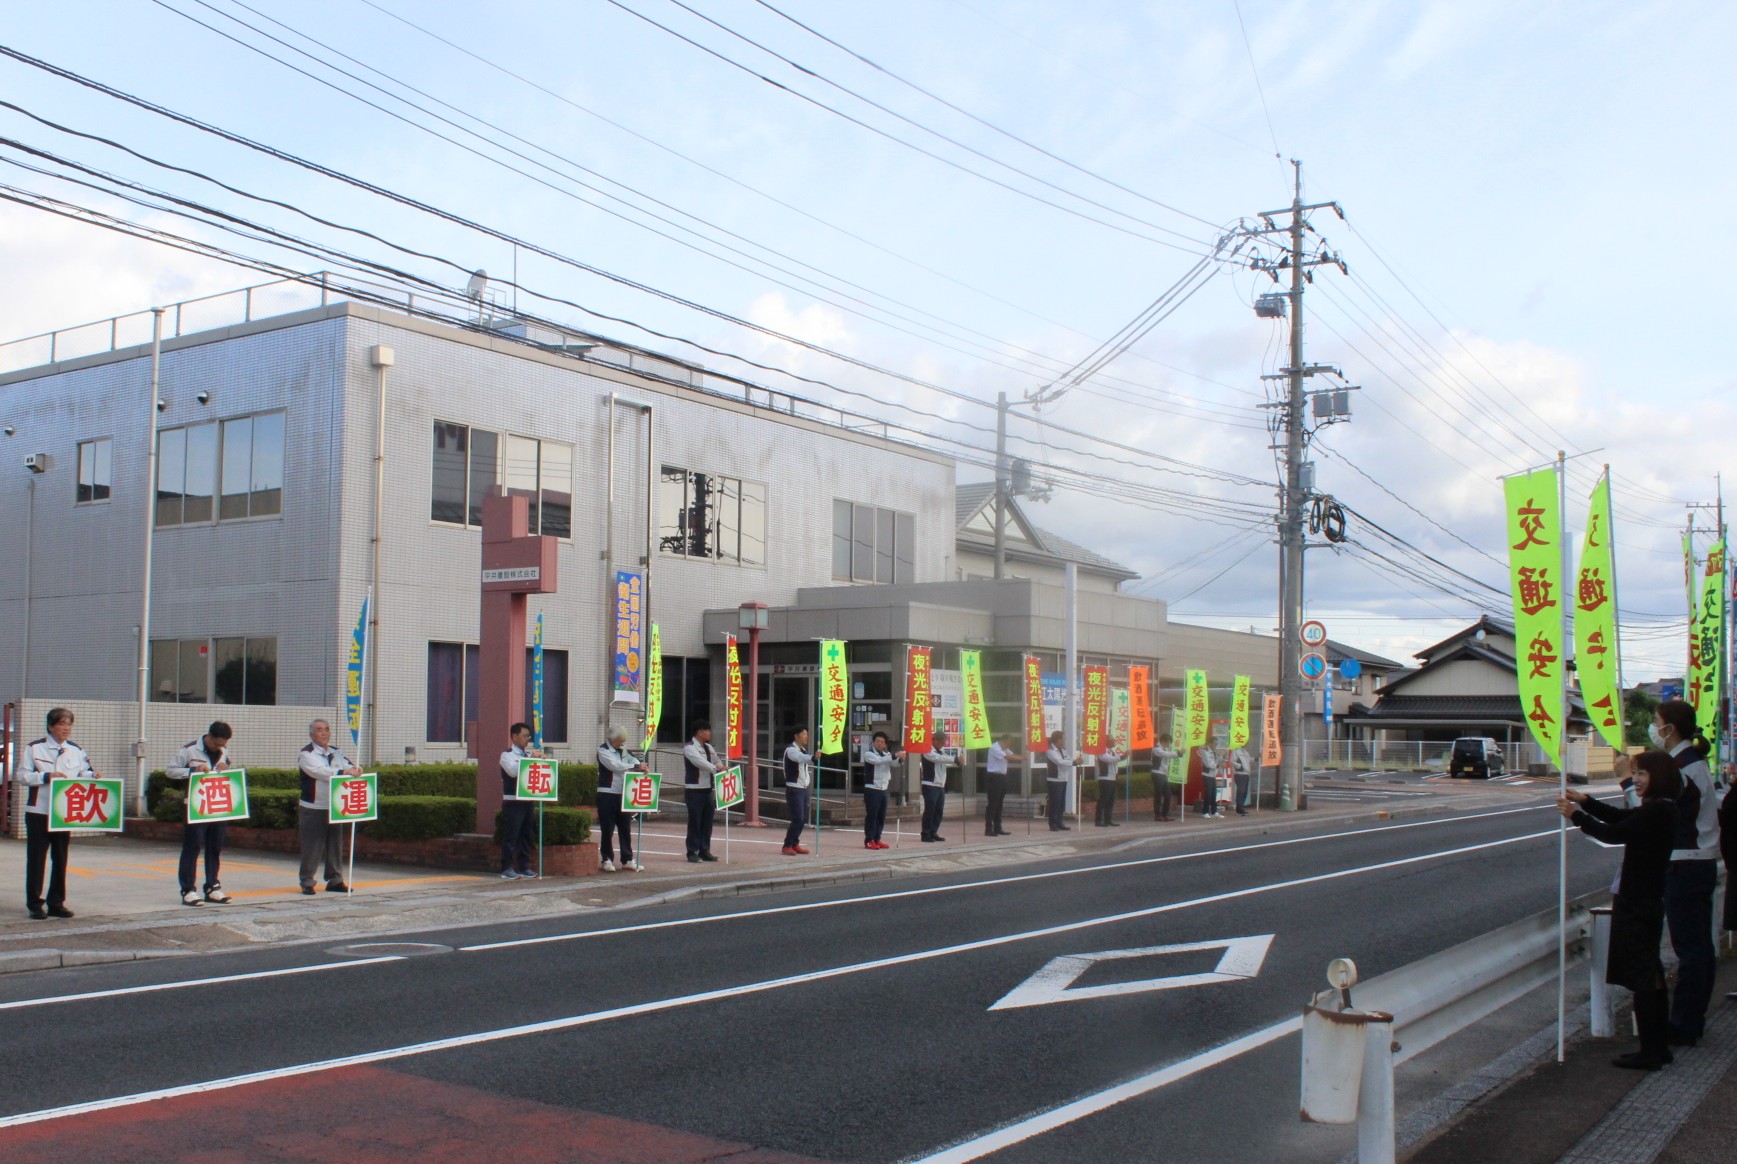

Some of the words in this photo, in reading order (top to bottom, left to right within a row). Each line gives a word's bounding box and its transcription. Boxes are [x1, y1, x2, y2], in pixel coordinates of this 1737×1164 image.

[1306, 628, 1321, 639] 40
[827, 663, 845, 744] 交通安全
[909, 654, 927, 744] 夜光反射材
[966, 672, 986, 740] 交通安全
[1028, 663, 1041, 743] 夜光反射材
[1086, 672, 1102, 746] 夜光反射材
[1133, 671, 1148, 742] 飲酒運転追放
[1191, 685, 1206, 740] 交通安全
[1234, 683, 1248, 744] 交通安全
[1267, 699, 1277, 760] 飲酒運転追放
[63, 782, 109, 824] 飲
[198, 776, 234, 816] 酒
[341, 780, 368, 816] 運
[527, 763, 551, 794] 転
[630, 777, 652, 806] 追
[721, 772, 739, 802] 放
